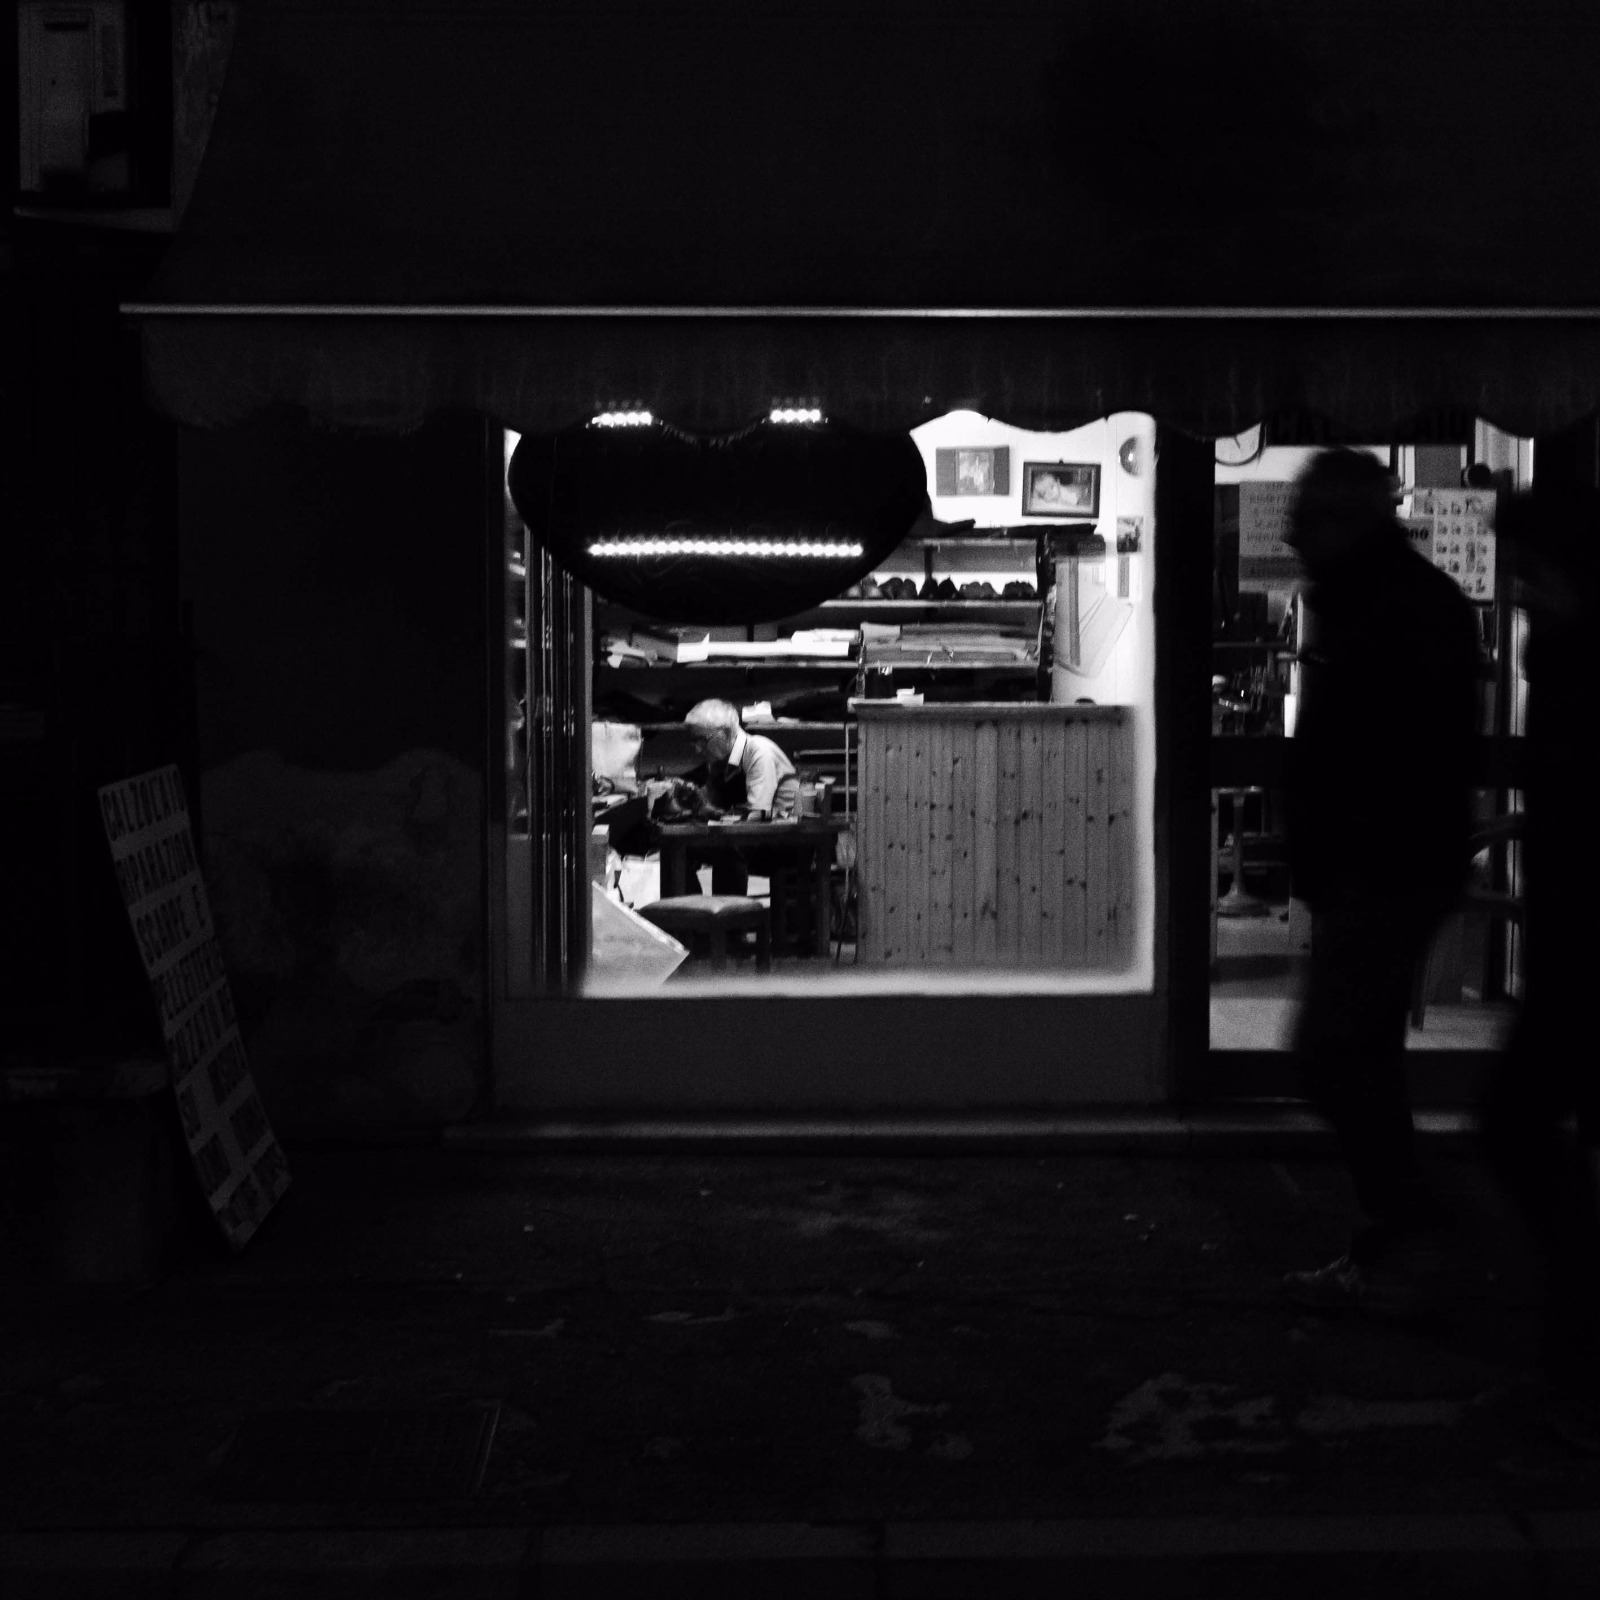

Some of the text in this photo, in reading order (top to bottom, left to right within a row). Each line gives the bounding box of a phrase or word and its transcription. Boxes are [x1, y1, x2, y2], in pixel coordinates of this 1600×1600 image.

[1271, 410, 1467, 442] CALAIO
[100, 768, 187, 841] CALZOLAIO
[133, 883, 206, 965] SCARPE E
